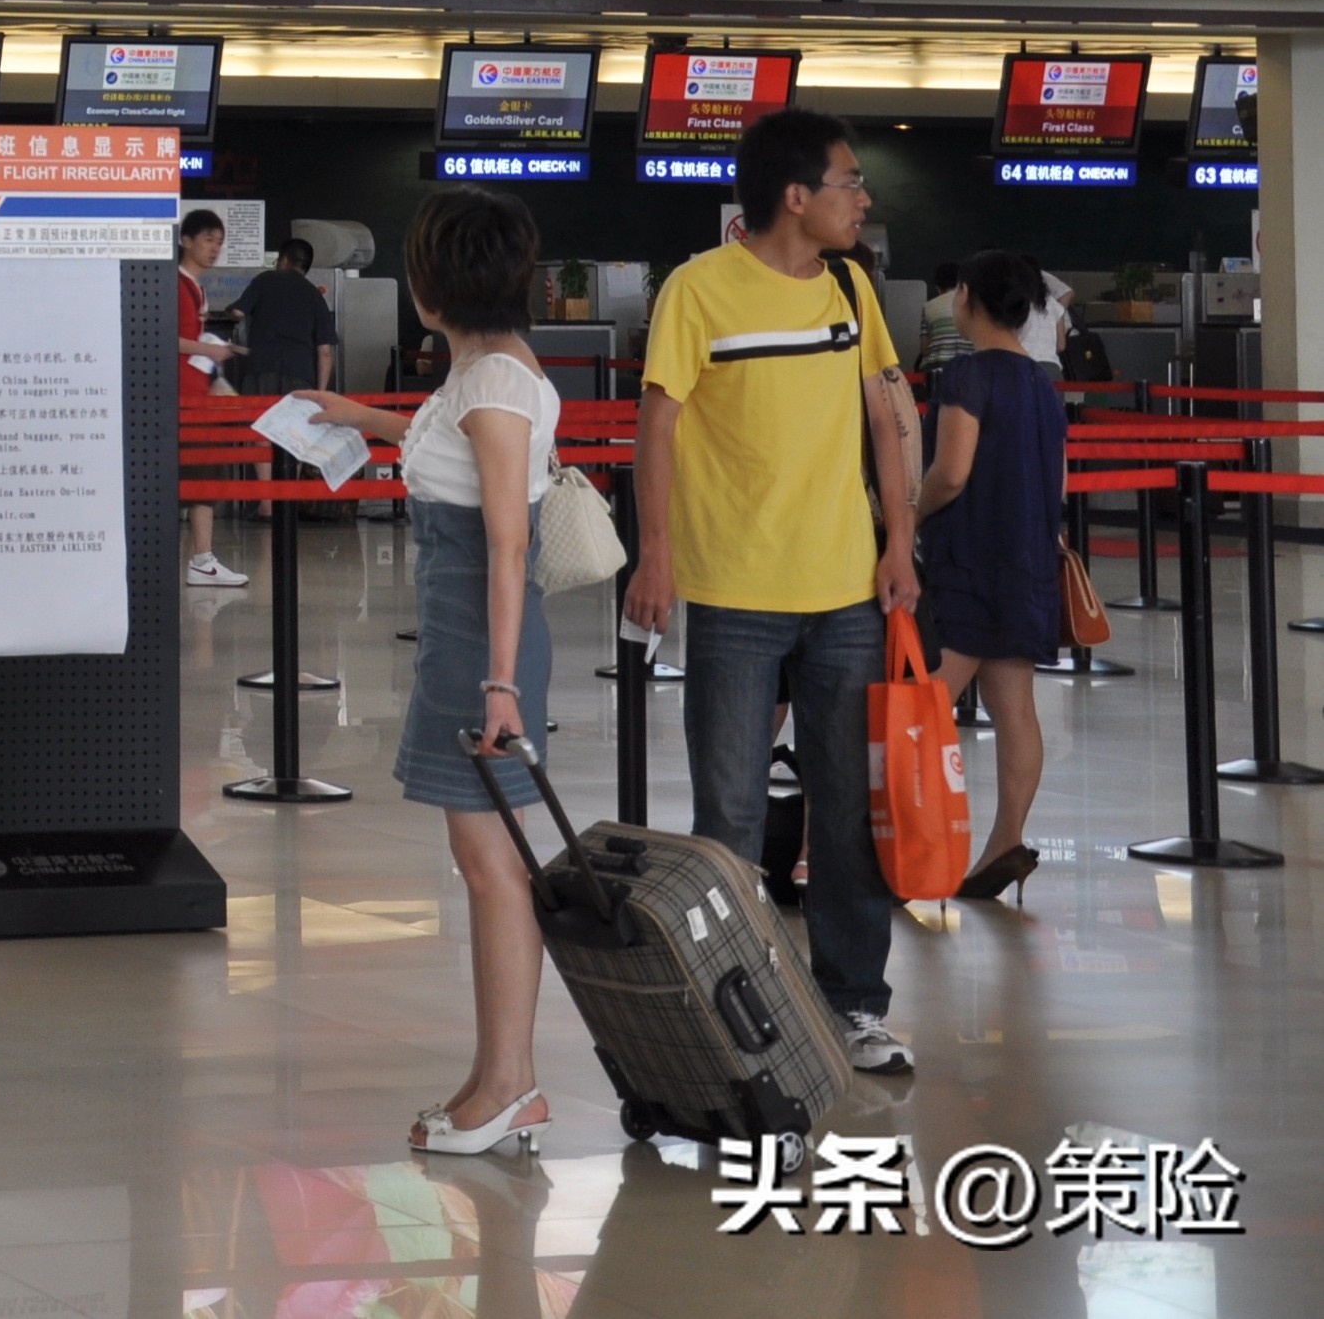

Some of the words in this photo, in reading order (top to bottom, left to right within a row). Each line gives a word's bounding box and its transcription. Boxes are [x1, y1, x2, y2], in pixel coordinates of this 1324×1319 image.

[86, 107, 120, 116] Economy
[166, 108, 185, 117] flight
[464, 114, 535, 125] Golden/Silver
[538, 115, 563, 125] Card
[687, 117, 711, 128] First
[713, 118, 742, 128] Class
[1042, 122, 1065, 132] First
[1068, 122, 1094, 133] Class
[444, 157, 467, 174] 66
[470, 158, 523, 175] 值机柜台
[528, 160, 580, 172] CHECK-IN
[645, 160, 667, 177] 65
[670, 161, 722, 178] 值机柜台
[3, 166, 58, 180] FLIGHT
[62, 167, 175, 181] IRREGULARITY
[1001, 164, 1021, 181] 64
[1025, 165, 1074, 181] 值机柜台
[1079, 167, 1128, 180] CHECK-IN
[1195, 167, 1217, 184] 63
[2, 376, 28, 385] China
[33, 376, 69, 385] Eastern
[8, 388, 18, 397] to
[23, 388, 59, 398] suggest
[64, 388, 80, 397] you
[85, 387, 108, 396] that:
[23, 433, 63, 443] baggage,
[69, 433, 85, 442] you
[18, 488, 55, 497] Eastern
[60, 487, 96, 496] On-line
[19, 544, 56, 553] EASTERN
[61, 542, 102, 552] AIRLINES
